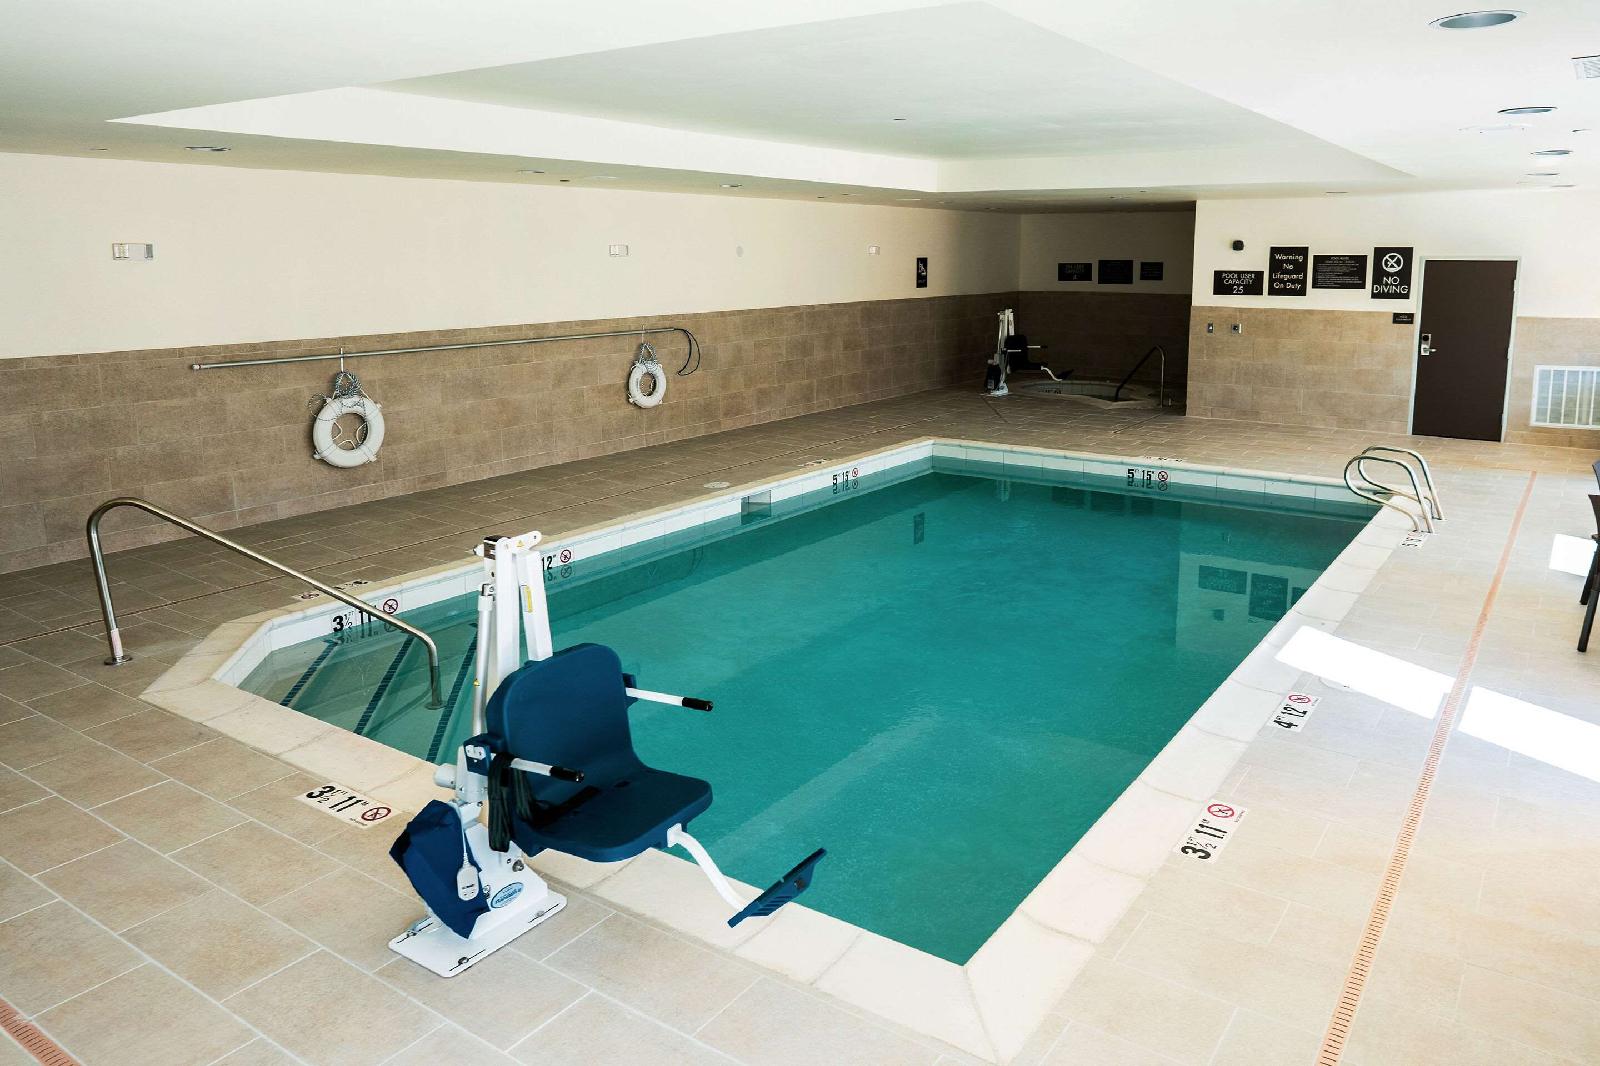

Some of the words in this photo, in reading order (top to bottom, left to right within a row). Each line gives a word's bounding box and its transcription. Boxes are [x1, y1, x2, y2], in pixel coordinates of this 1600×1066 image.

[1274, 253, 1304, 262] Warning
[1221, 272, 1238, 280] POOL
[1272, 271, 1304, 281] Lifeguard
[1382, 276, 1400, 285] NO
[1232, 286, 1244, 294] 25
[1286, 282, 1302, 290] Duty
[1373, 284, 1409, 294] DIVING
[1127, 468, 1135, 479] 5
